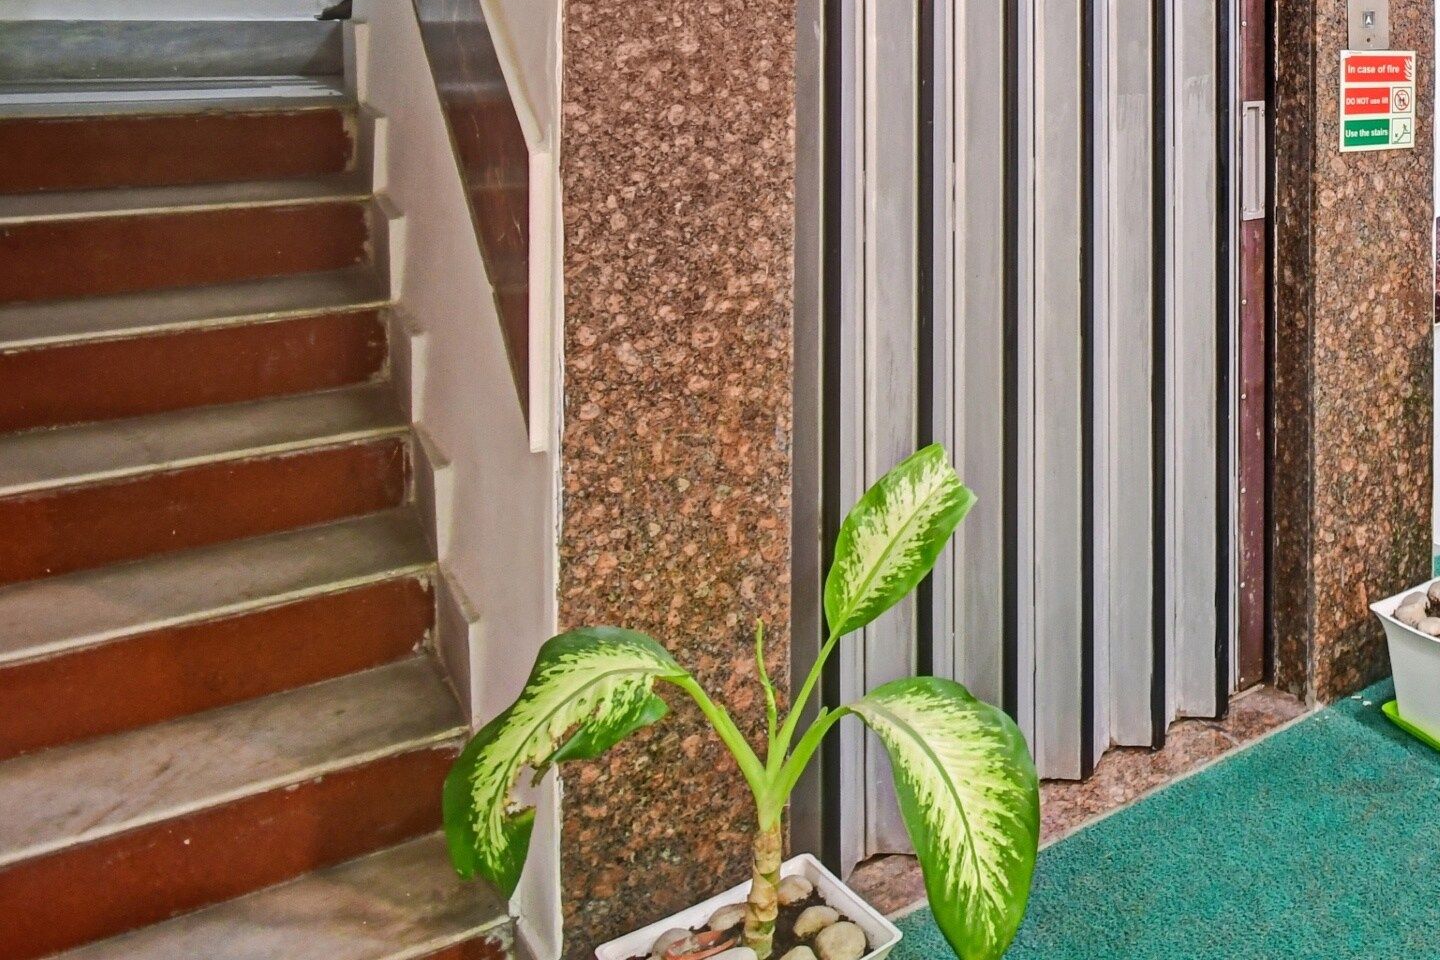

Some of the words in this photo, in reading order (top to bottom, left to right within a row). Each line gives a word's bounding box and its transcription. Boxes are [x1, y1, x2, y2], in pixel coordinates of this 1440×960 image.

[1347, 64, 1356, 74] In
[1357, 65, 1376, 74] case
[1377, 64, 1386, 74] of
[1386, 64, 1400, 74] fire
[1346, 97, 1356, 106] DO
[1356, 96, 1369, 105] NOT
[1345, 129, 1359, 138] Use
[1359, 128, 1370, 137] the
[1370, 127, 1389, 136] stairs
